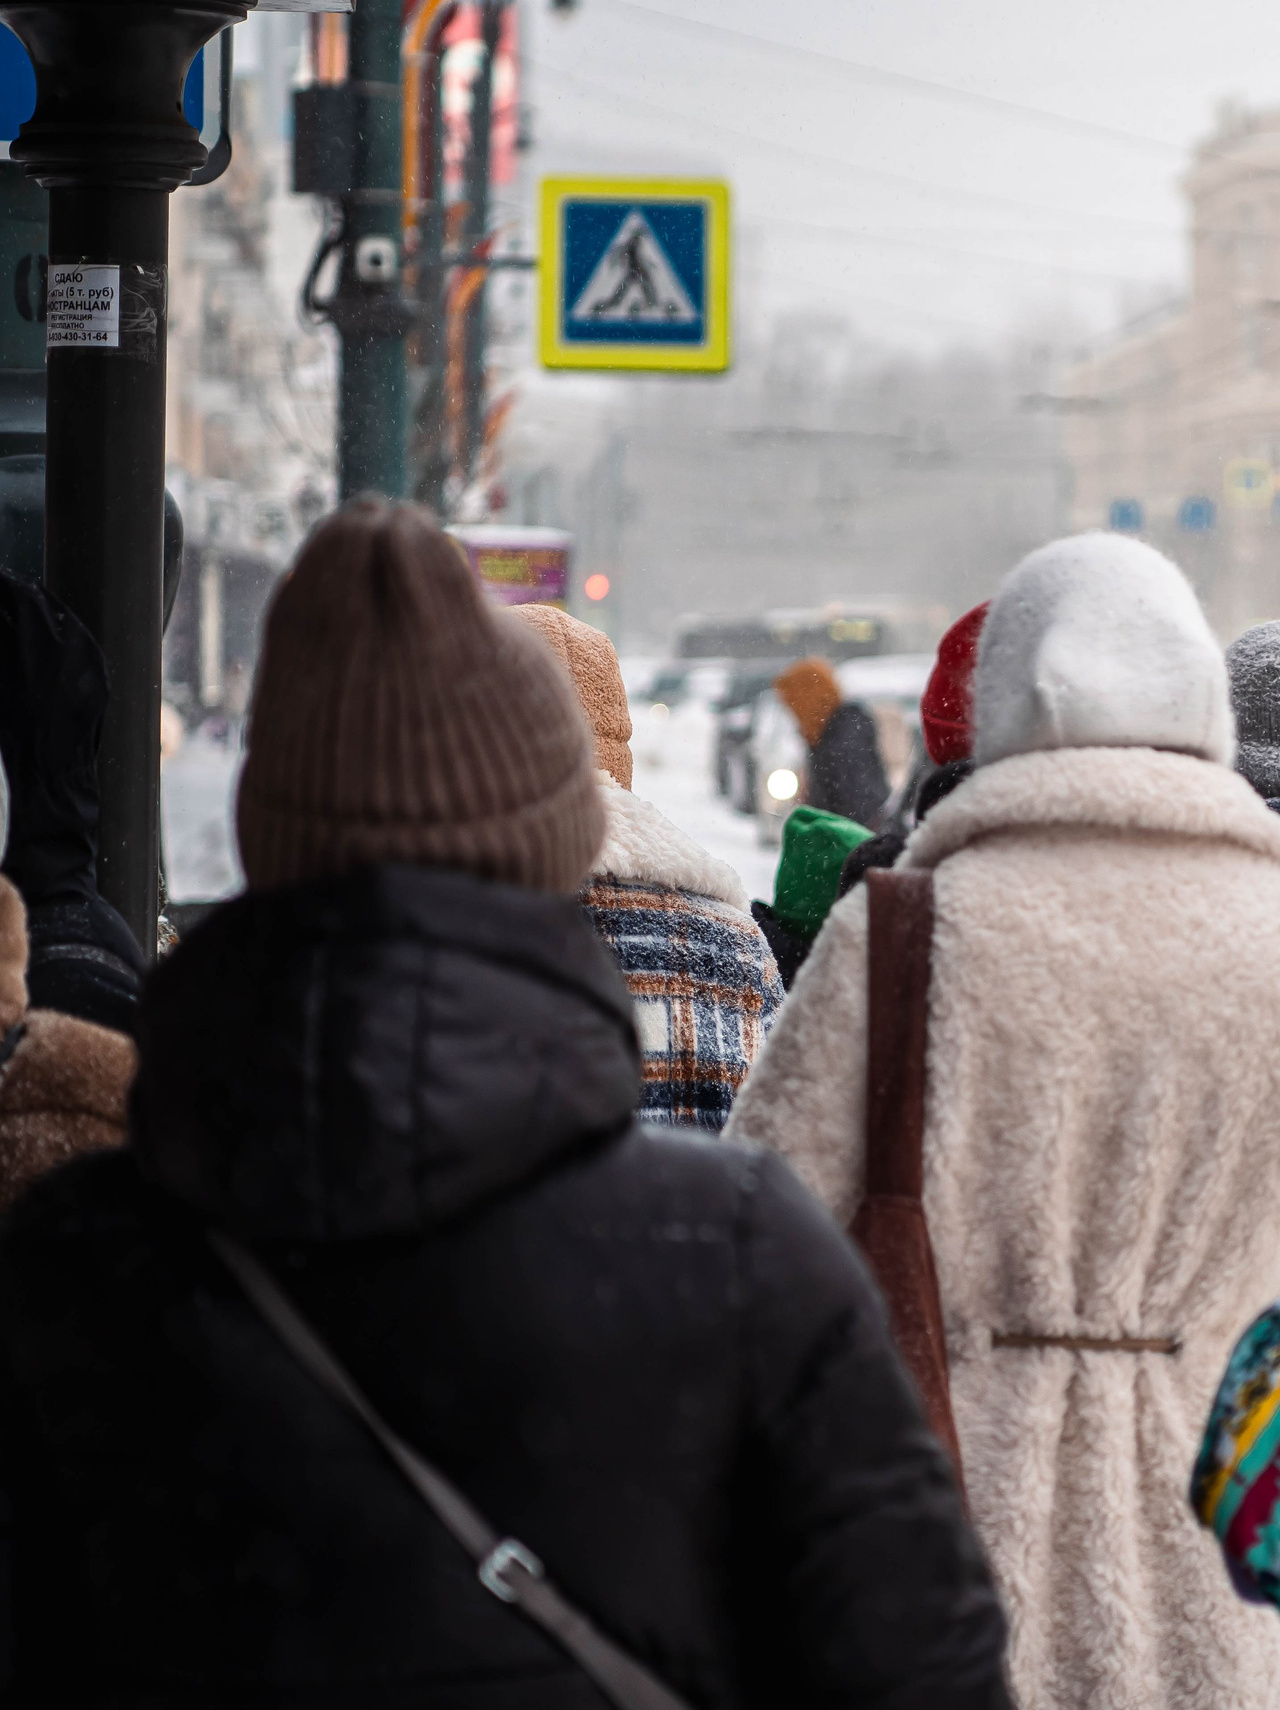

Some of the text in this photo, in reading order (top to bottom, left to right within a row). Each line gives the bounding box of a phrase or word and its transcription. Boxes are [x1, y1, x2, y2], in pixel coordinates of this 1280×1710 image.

[55, 273, 83, 284] СДАЮ
[50, 287, 114, 299] АТЫ (5 т. руб)
[48, 300, 111, 312] ОСТРАНЦАМ
